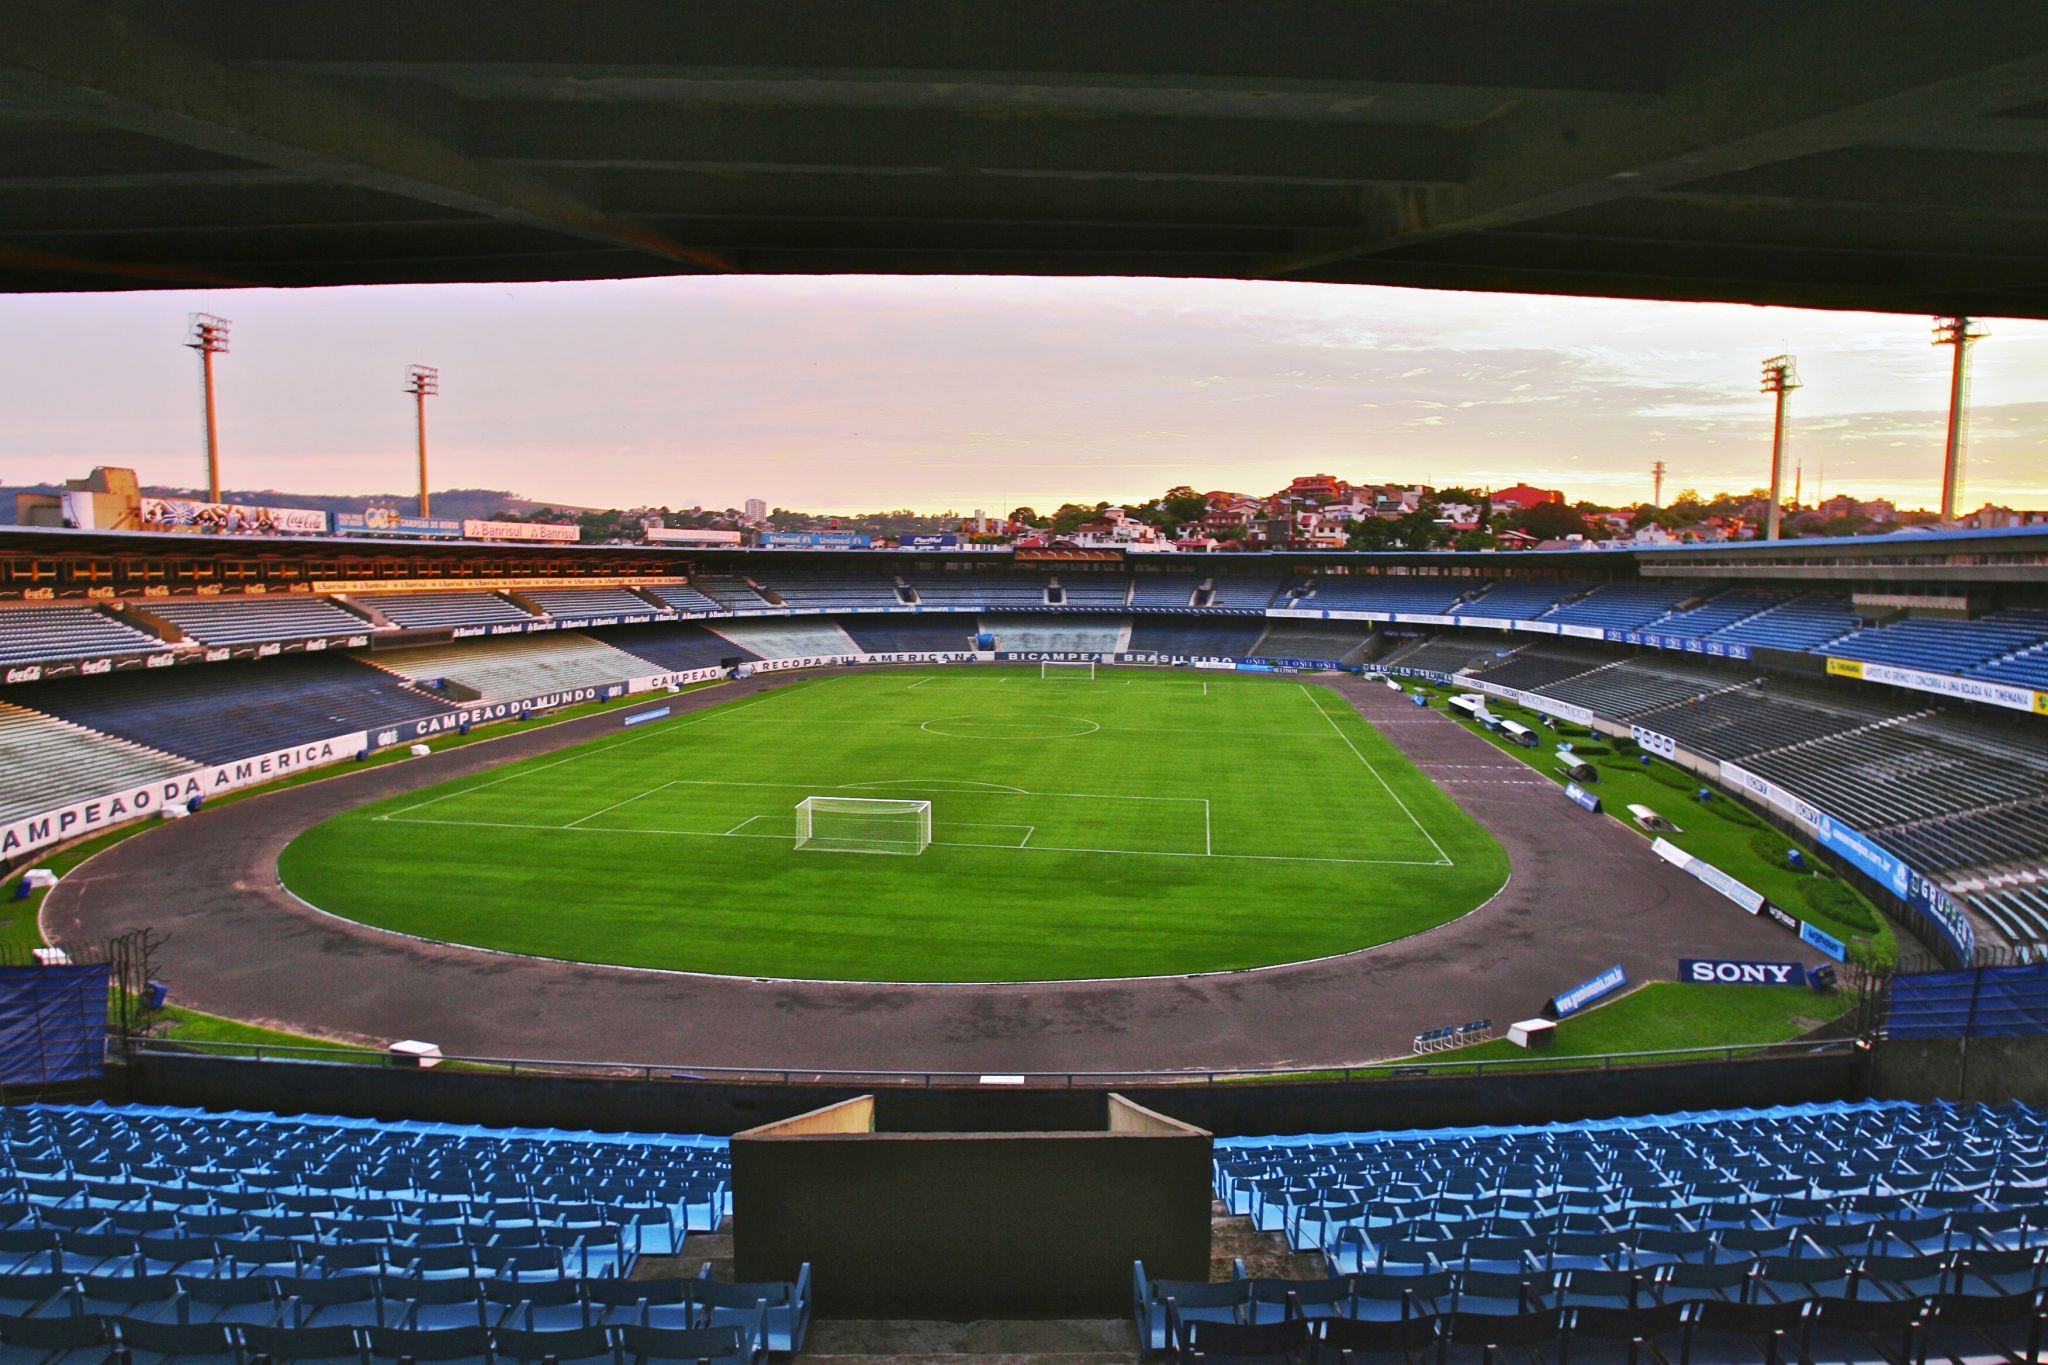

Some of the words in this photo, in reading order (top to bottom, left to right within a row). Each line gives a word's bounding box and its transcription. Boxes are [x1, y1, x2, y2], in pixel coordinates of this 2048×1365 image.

[482, 523, 522, 537] Banrisul
[540, 526, 576, 540] Banrisul
[770, 535, 800, 544] Unimed
[819, 537, 850, 545] Unimed
[763, 658, 822, 670] RECOPA
[868, 653, 978, 662] AMERICANA
[1994, 688, 2028, 705] TIMEMANIA
[416, 705, 505, 734] CAMPEÃO
[511, 701, 532, 714] DO
[537, 688, 595, 709] MUNDO
[164, 777, 200, 800] DA
[215, 743, 333, 787] AMÉRICA
[1692, 962, 1791, 983] SONY
